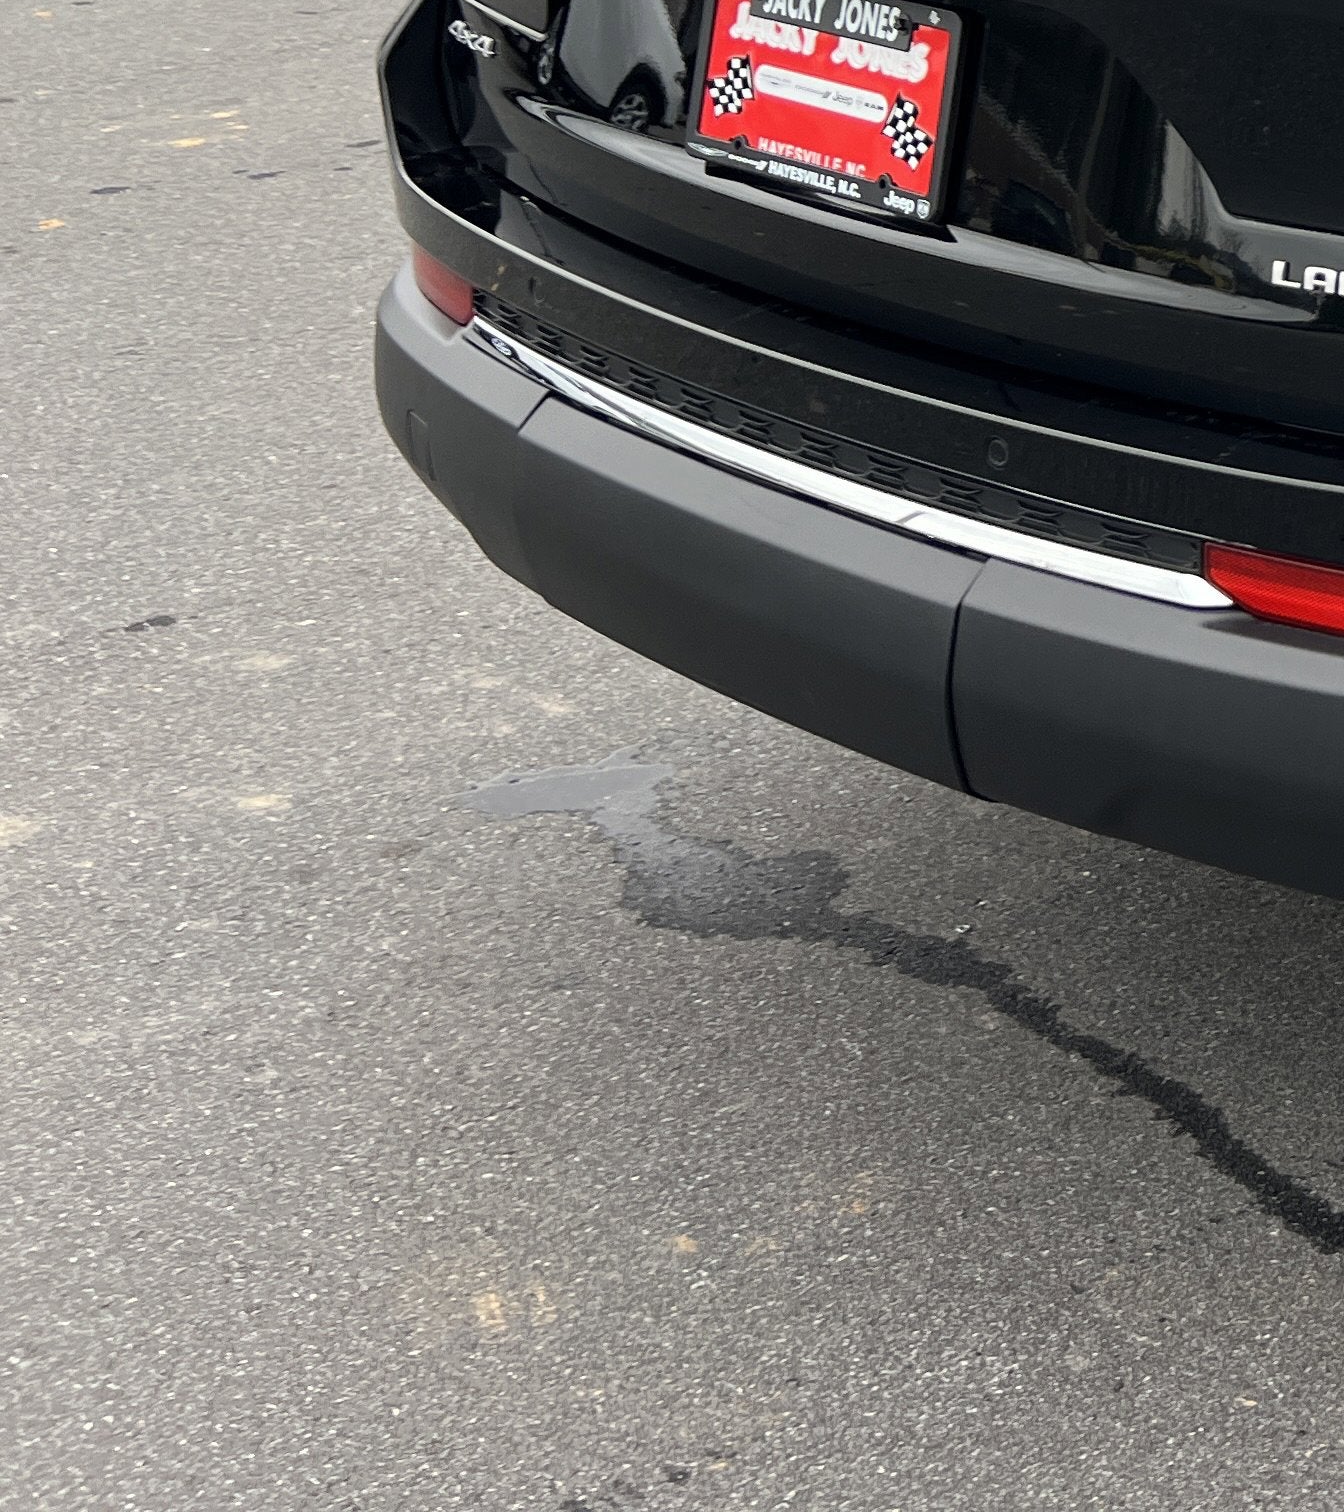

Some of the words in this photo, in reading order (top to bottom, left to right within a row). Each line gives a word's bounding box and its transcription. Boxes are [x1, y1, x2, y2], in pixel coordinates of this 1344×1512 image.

[729, 1, 819, 55] JACKY
[830, 37, 931, 83] JONES
[767, 160, 836, 194] HAYESVILLE,
[883, 190, 915, 215] Jeep
